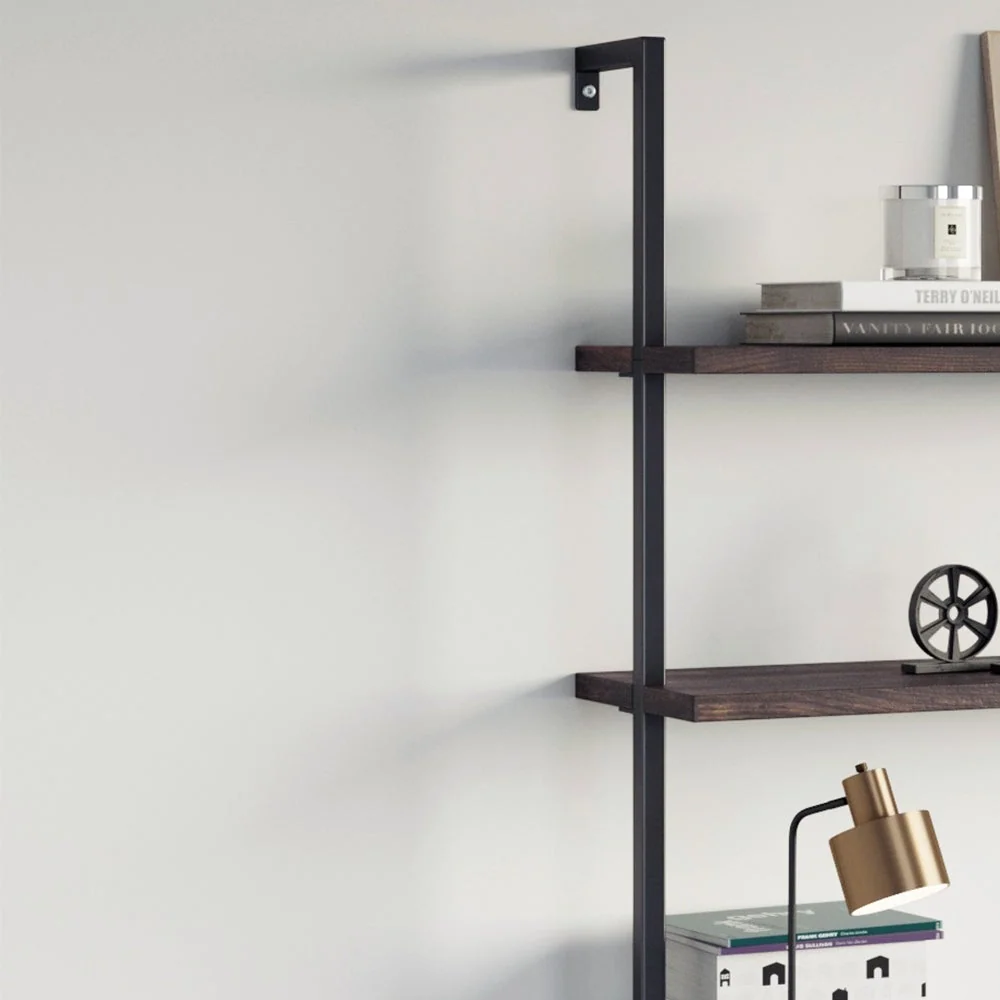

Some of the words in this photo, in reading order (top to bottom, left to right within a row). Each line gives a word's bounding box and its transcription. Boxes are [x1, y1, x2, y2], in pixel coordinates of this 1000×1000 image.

[915, 289, 957, 304] TERRY
[843, 322, 914, 335] VANITY
[921, 322, 964, 335] FAIR
